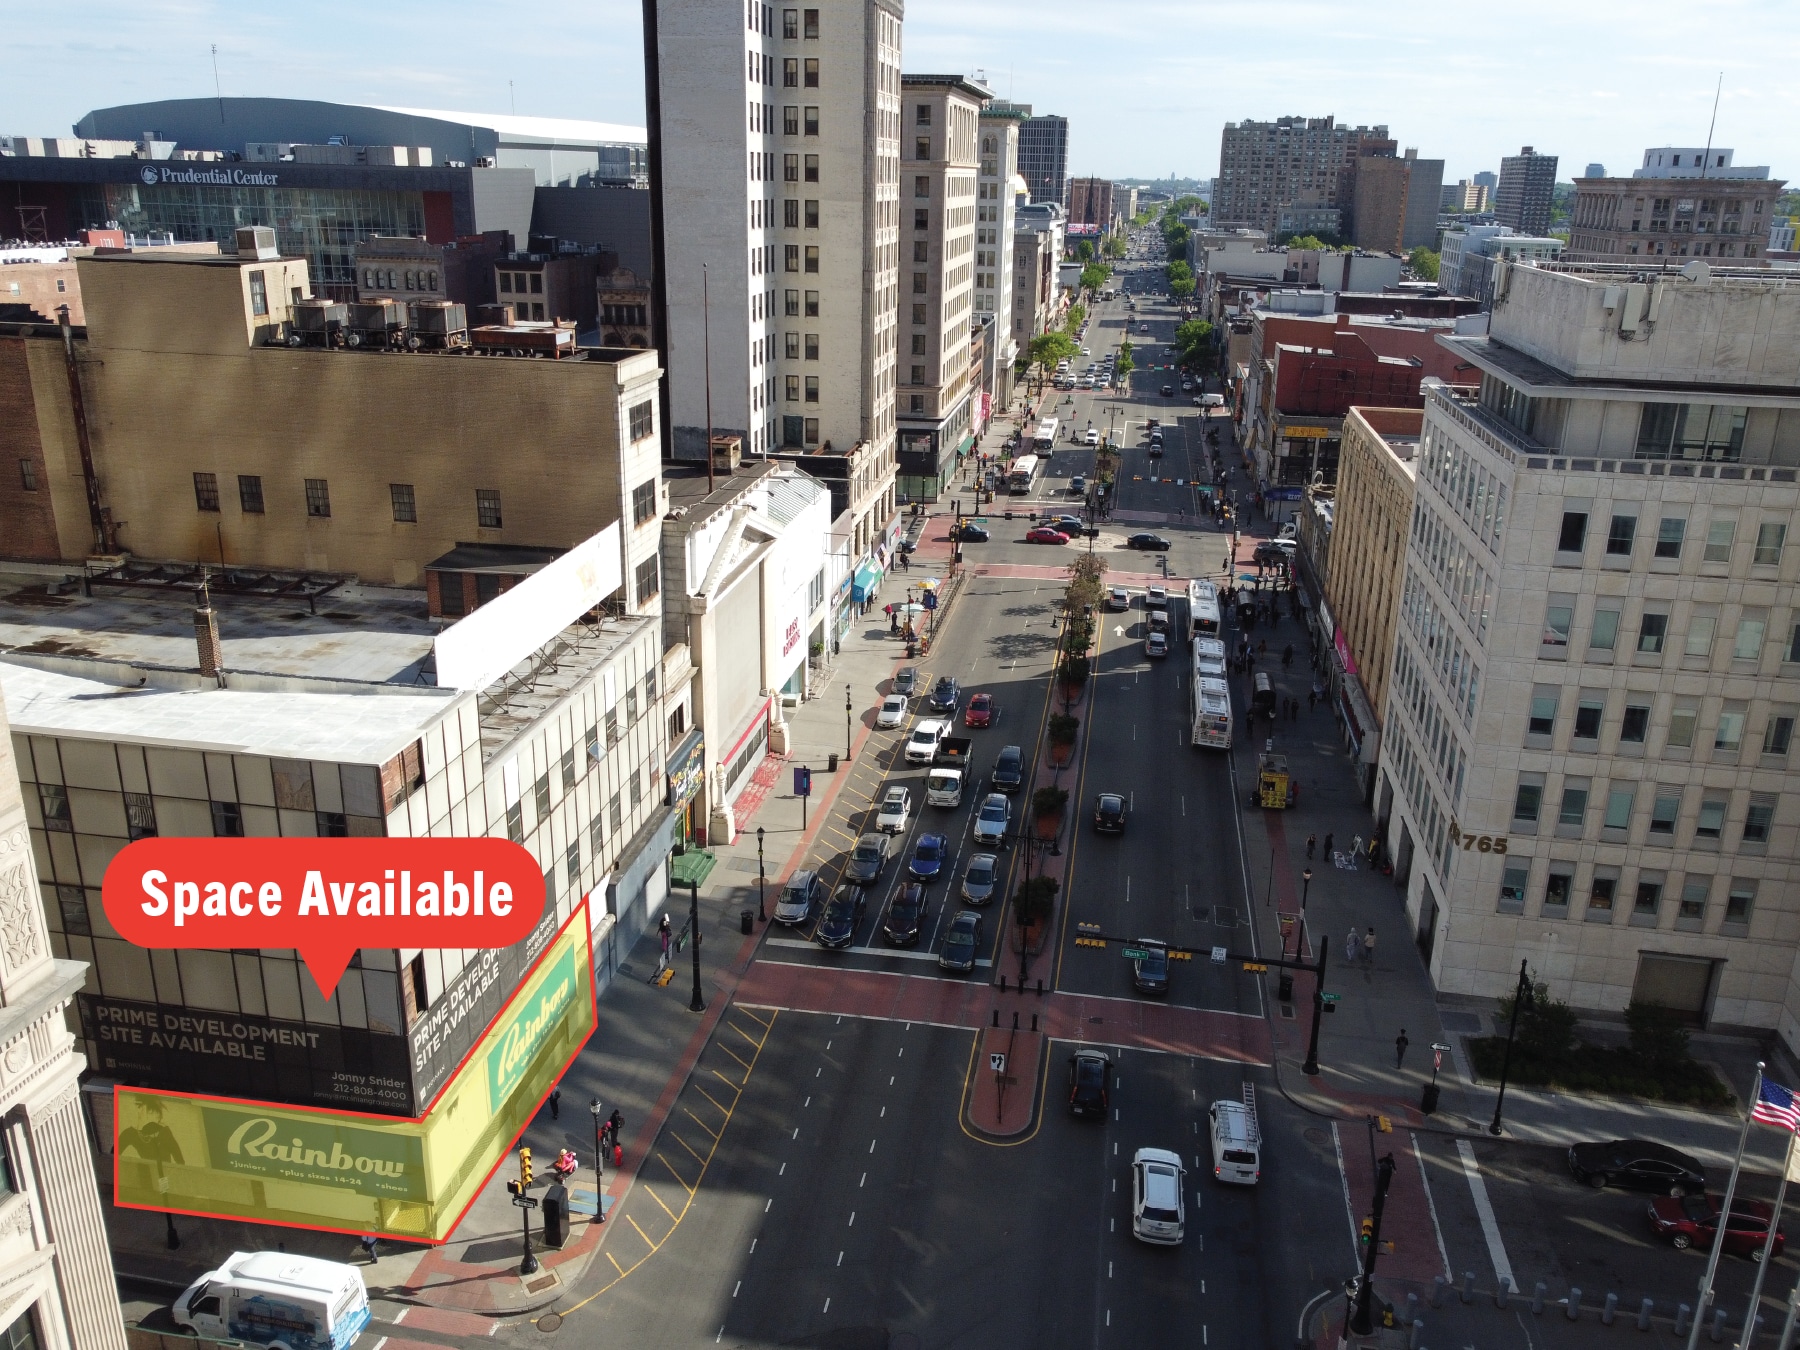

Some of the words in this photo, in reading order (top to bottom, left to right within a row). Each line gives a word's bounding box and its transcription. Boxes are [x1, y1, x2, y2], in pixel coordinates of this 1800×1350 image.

[160, 168, 233, 184] Prudential
[234, 169, 278, 186] Center
[1462, 834, 1508, 855] 765
[97, 1006, 159, 1028] PRIME
[164, 1014, 320, 1049] DEVELOPMENT
[413, 1001, 449, 1054] PRIME
[416, 1032, 441, 1073] SITE
[443, 961, 500, 1042] AVAILABLE
[497, 977, 569, 1087] Rainbow
[100, 1025, 144, 1045] SITE
[150, 1032, 266, 1061] AVAILABLE
[332, 1071, 366, 1084] Jonny
[369, 1076, 406, 1089] Snider
[333, 1083, 407, 1101] 212-808-4000
[228, 1118, 405, 1178] Rainbow
[233, 1161, 267, 1172] juniors
[285, 1169, 305, 1178] plus
[308, 1172, 330, 1181] sizes
[334, 1176, 362, 1186] 14-24
[381, 1183, 409, 1192] shoes
